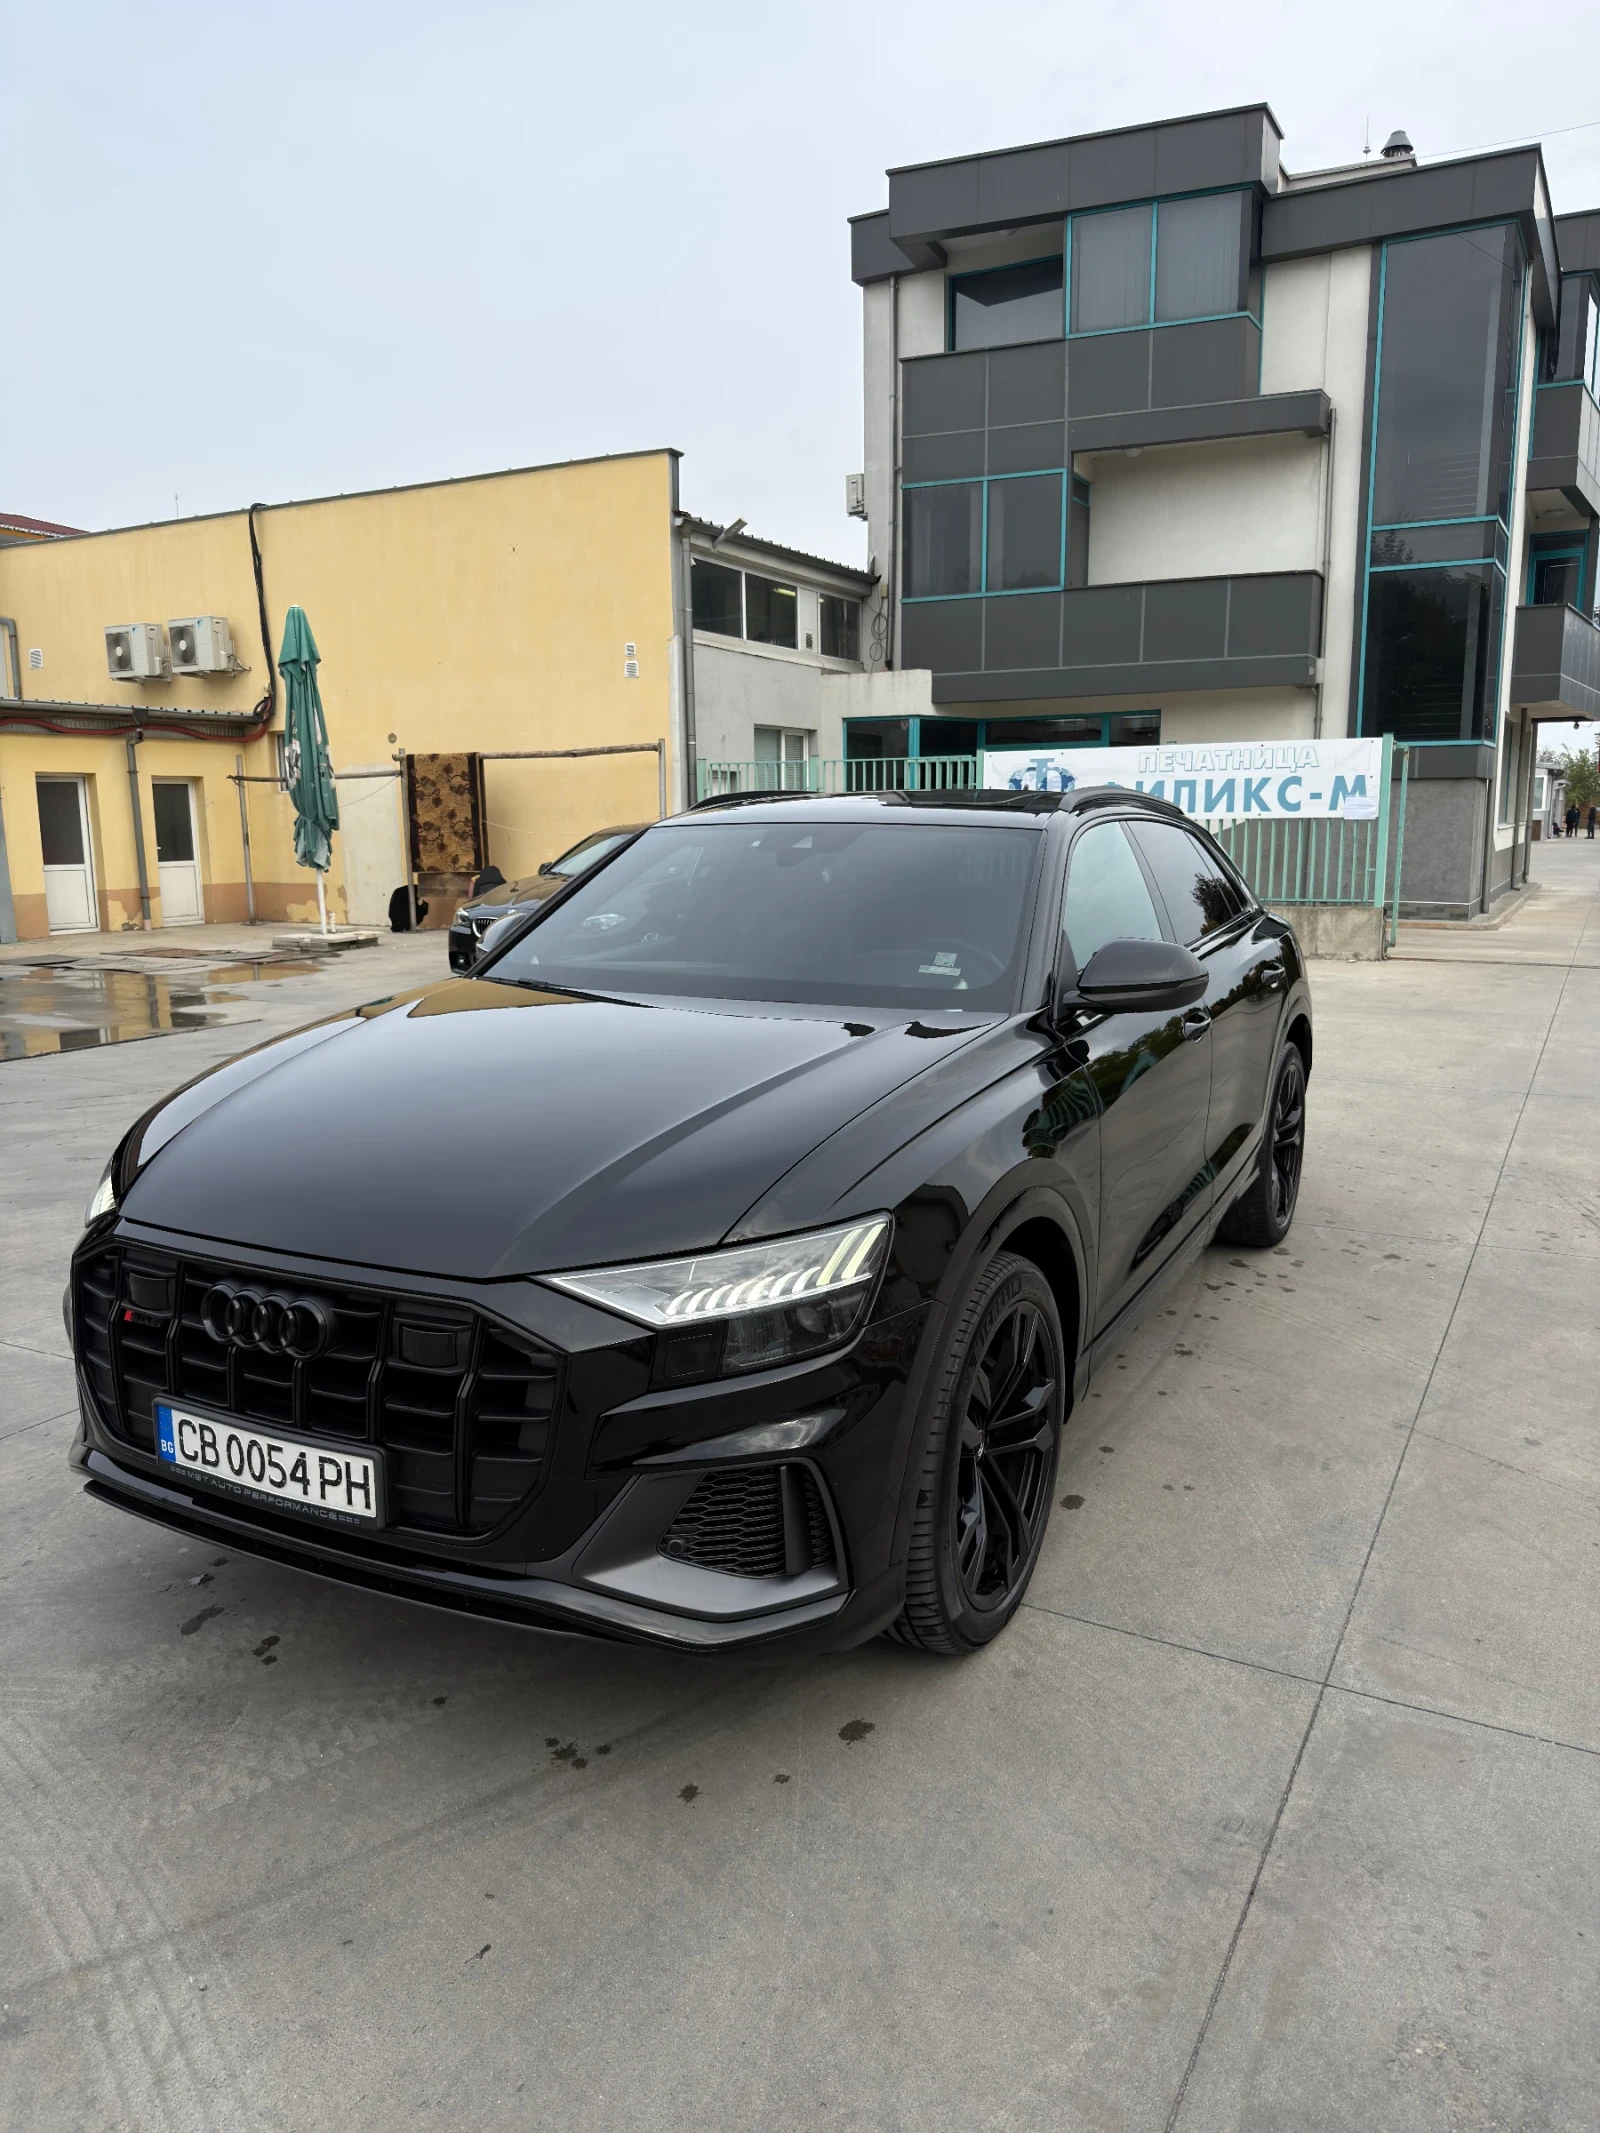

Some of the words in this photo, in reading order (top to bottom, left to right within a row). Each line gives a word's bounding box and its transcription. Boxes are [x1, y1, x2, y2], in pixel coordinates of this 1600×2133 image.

[1138, 746, 1320, 773] ПЕЧАТНИЦА
[160, 1438, 174, 1454] BG
[178, 1418, 220, 1468] CB
[226, 1433, 311, 1496] 0054
[318, 1455, 372, 1510] PH
[211, 1477, 241, 1494] AUTO
[243, 1490, 337, 1521] PERFORMANCE
